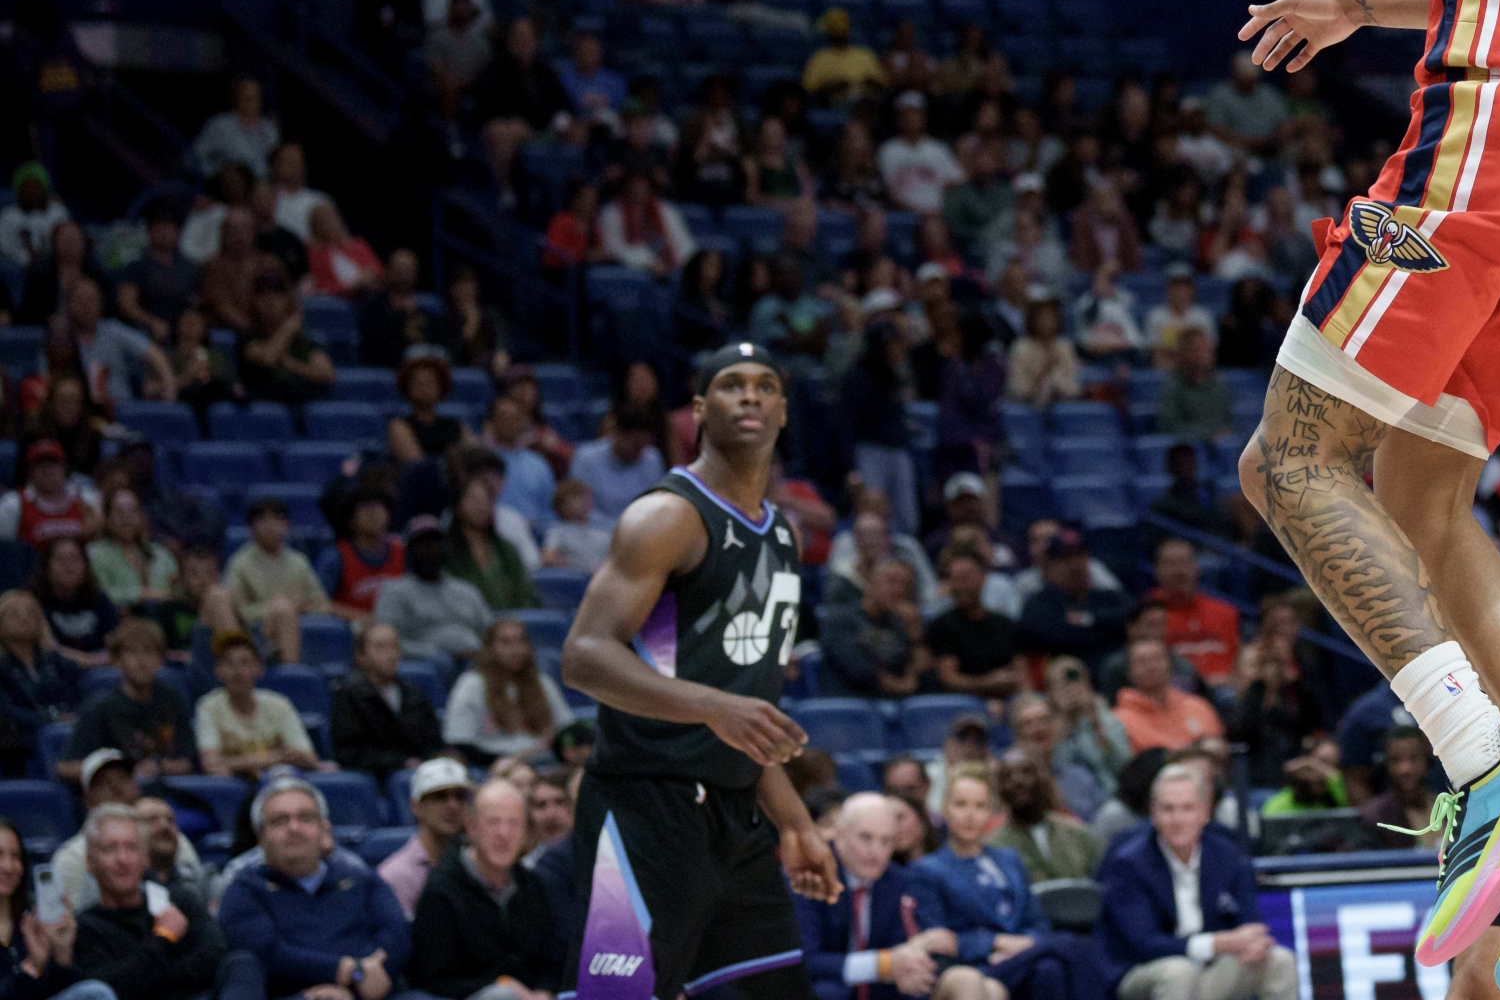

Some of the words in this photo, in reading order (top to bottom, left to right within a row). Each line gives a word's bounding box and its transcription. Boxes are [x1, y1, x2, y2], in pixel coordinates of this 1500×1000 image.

[1292, 417, 1320, 441] ITS
[1275, 435, 1319, 466] YOUR
[588, 952, 644, 977] UTAH
